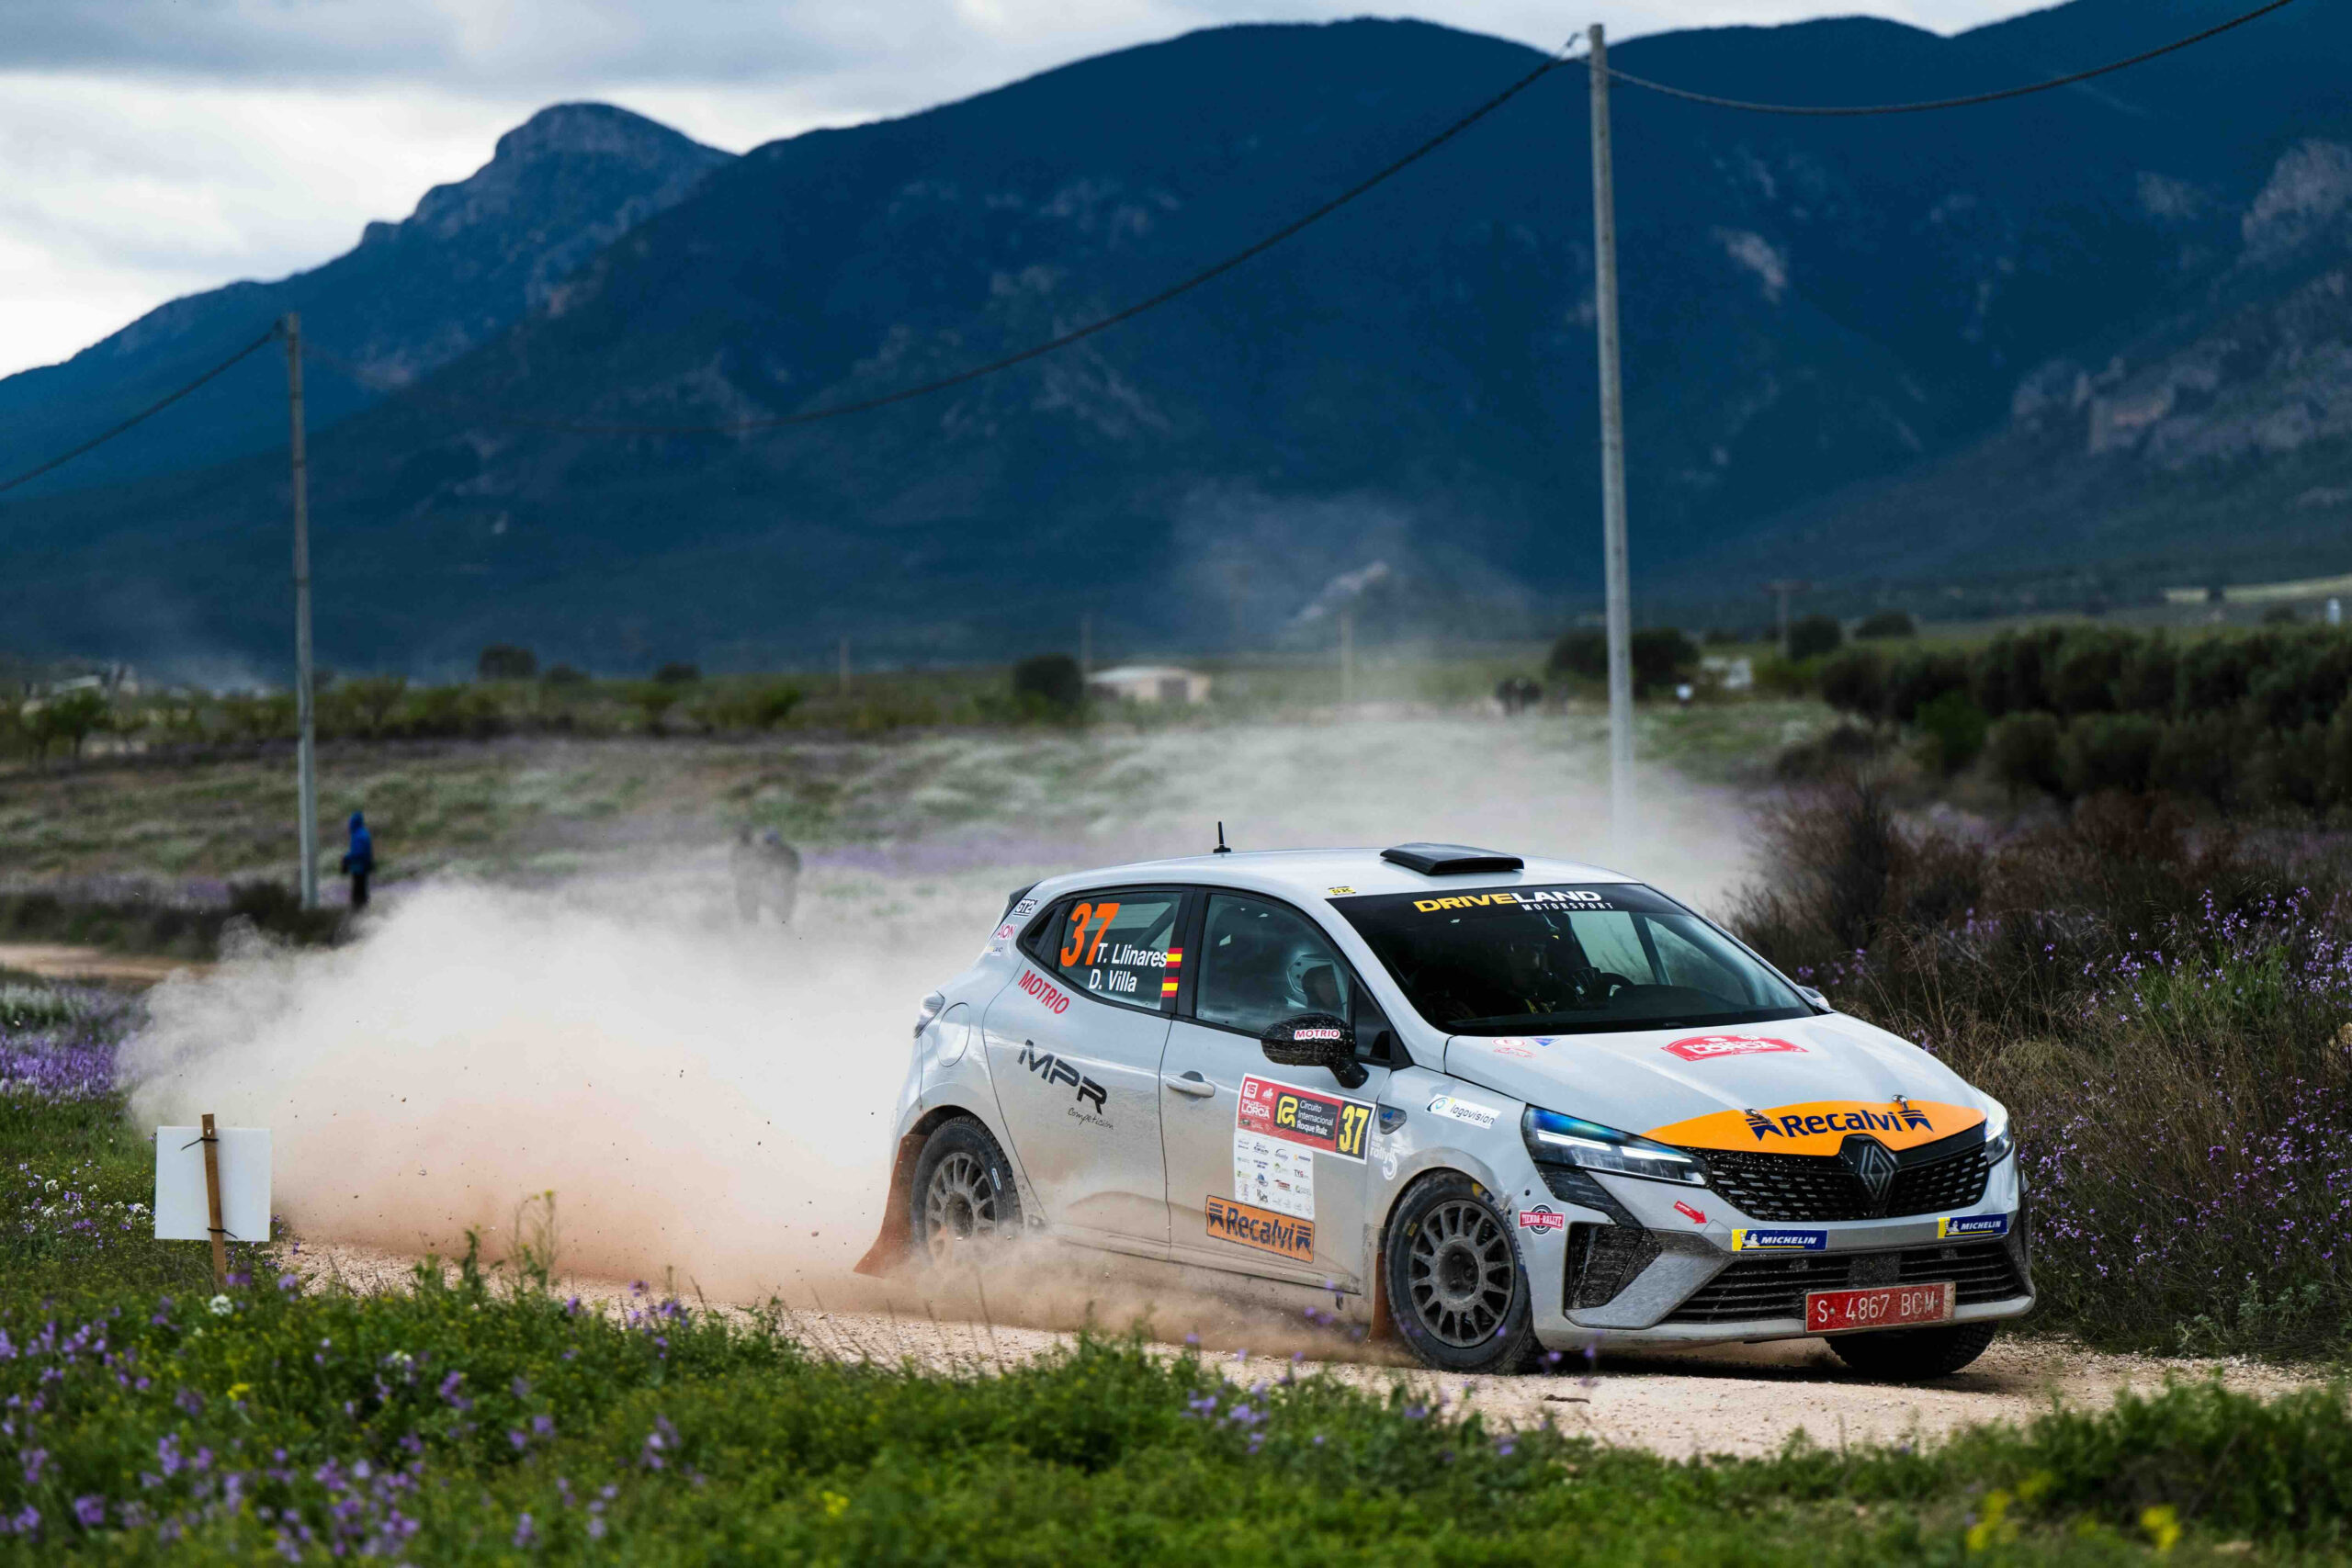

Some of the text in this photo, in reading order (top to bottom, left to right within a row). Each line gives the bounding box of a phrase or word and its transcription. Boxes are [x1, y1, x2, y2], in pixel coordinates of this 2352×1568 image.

[1413, 890, 1602, 913] DRIVELAND
[1521, 902, 1614, 911] MOTORSPORT
[1060, 902, 1121, 967] 37
[1097, 942, 1168, 968] T. Llinares
[1017, 969, 1069, 1014] MOTRIO
[1089, 968, 1138, 992] D. Villa
[1295, 1029, 1340, 1039] MOTRIO
[1017, 1038, 1108, 1115] MPR
[1240, 1102, 1270, 1119] LORCA
[1297, 1110, 1334, 1126] Internacional
[1299, 1100, 1322, 1113] Circuito
[1450, 1104, 1495, 1125] logovision
[1296, 1120, 1316, 1133] Roque
[1339, 1104, 1370, 1155] 37
[1779, 1110, 1904, 1138] Recalvi
[1227, 1206, 1295, 1252] Recalvi
[1960, 1220, 2002, 1231] MICHELIN
[1760, 1235, 1817, 1245] MICHELIN
[1817, 1300, 1828, 1323] S
[1845, 1293, 1890, 1321] 4867
